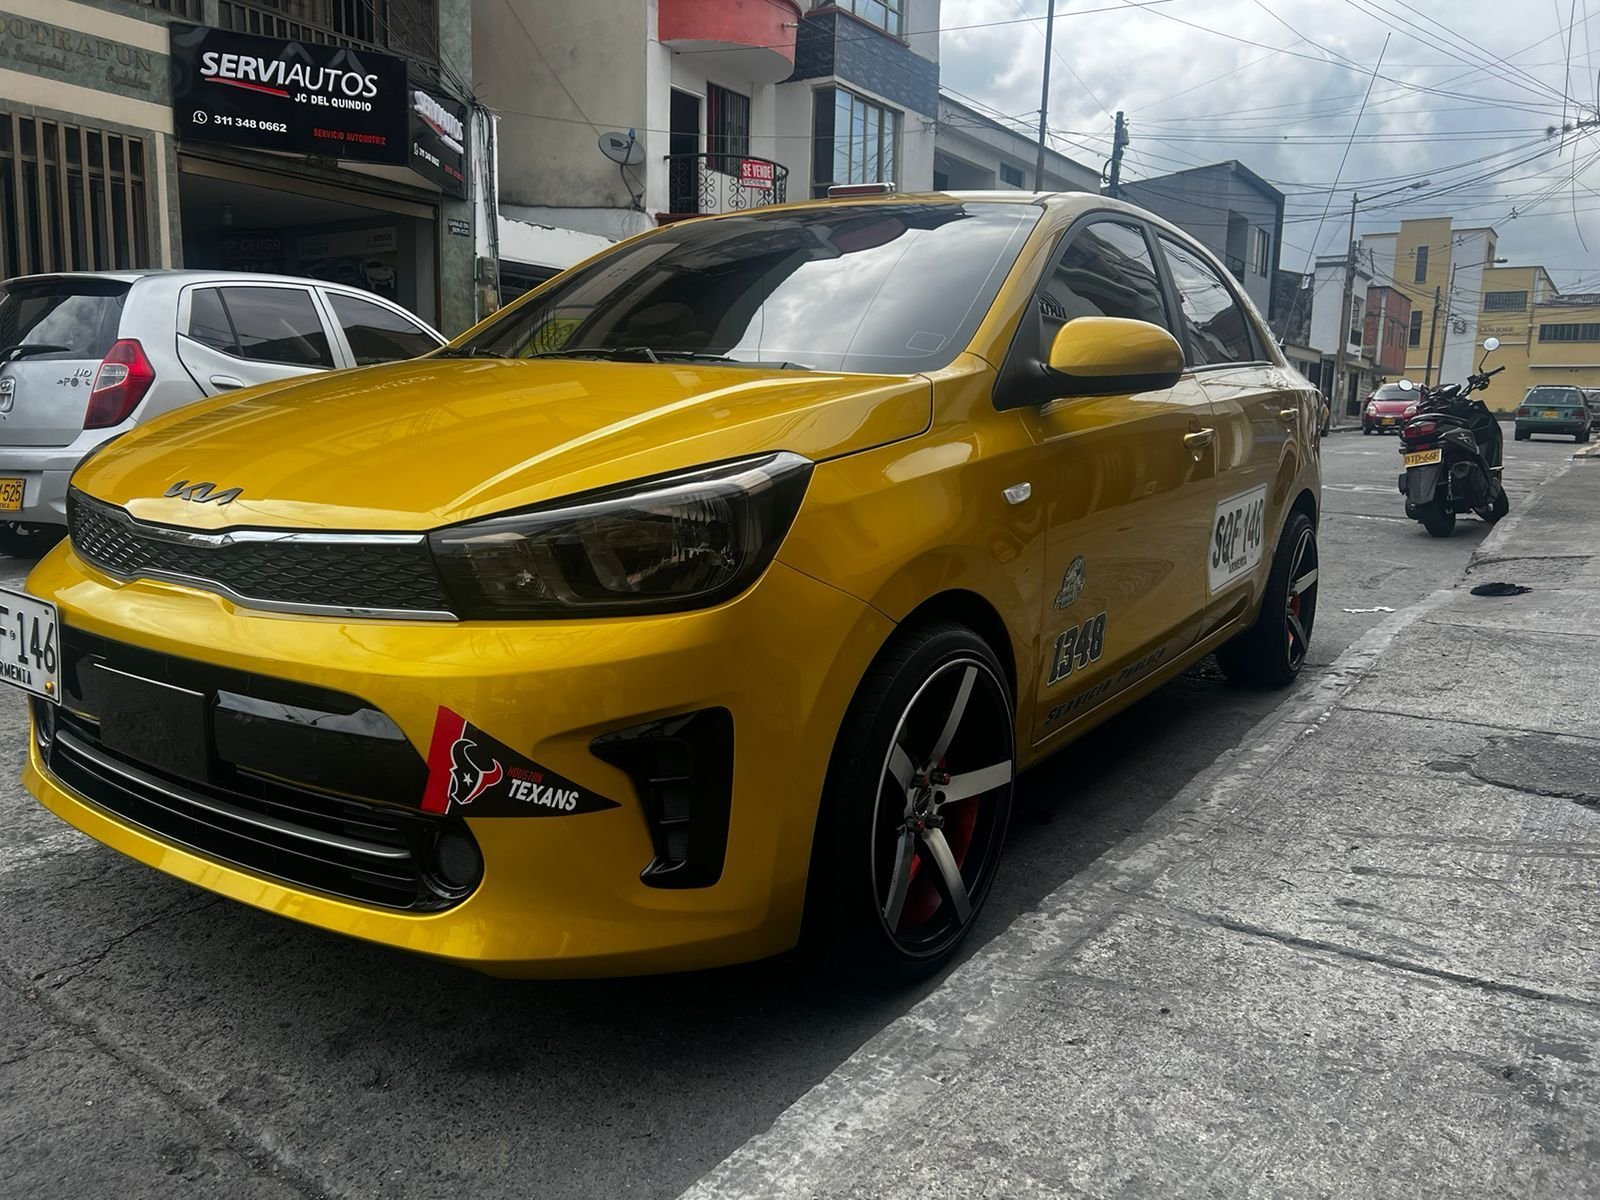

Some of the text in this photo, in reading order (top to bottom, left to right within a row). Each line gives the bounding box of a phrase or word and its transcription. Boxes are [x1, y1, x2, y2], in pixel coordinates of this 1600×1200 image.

[200, 51, 378, 98] SERVIAUTOS
[295, 93, 372, 112] JC DEL QUINDIO
[214, 115, 287, 133] 311 348 0662
[313, 128, 386, 146] SERVICIO AUTOMOTRIZ
[742, 163, 752, 177] SE
[163, 480, 244, 506] KIA
[17, 611, 55, 674] 146
[1047, 611, 1107, 687] 1348
[0, 661, 32, 685] RMENIA
[507, 766, 544, 784] HOUSTON
[508, 779, 579, 811] TEXANS
